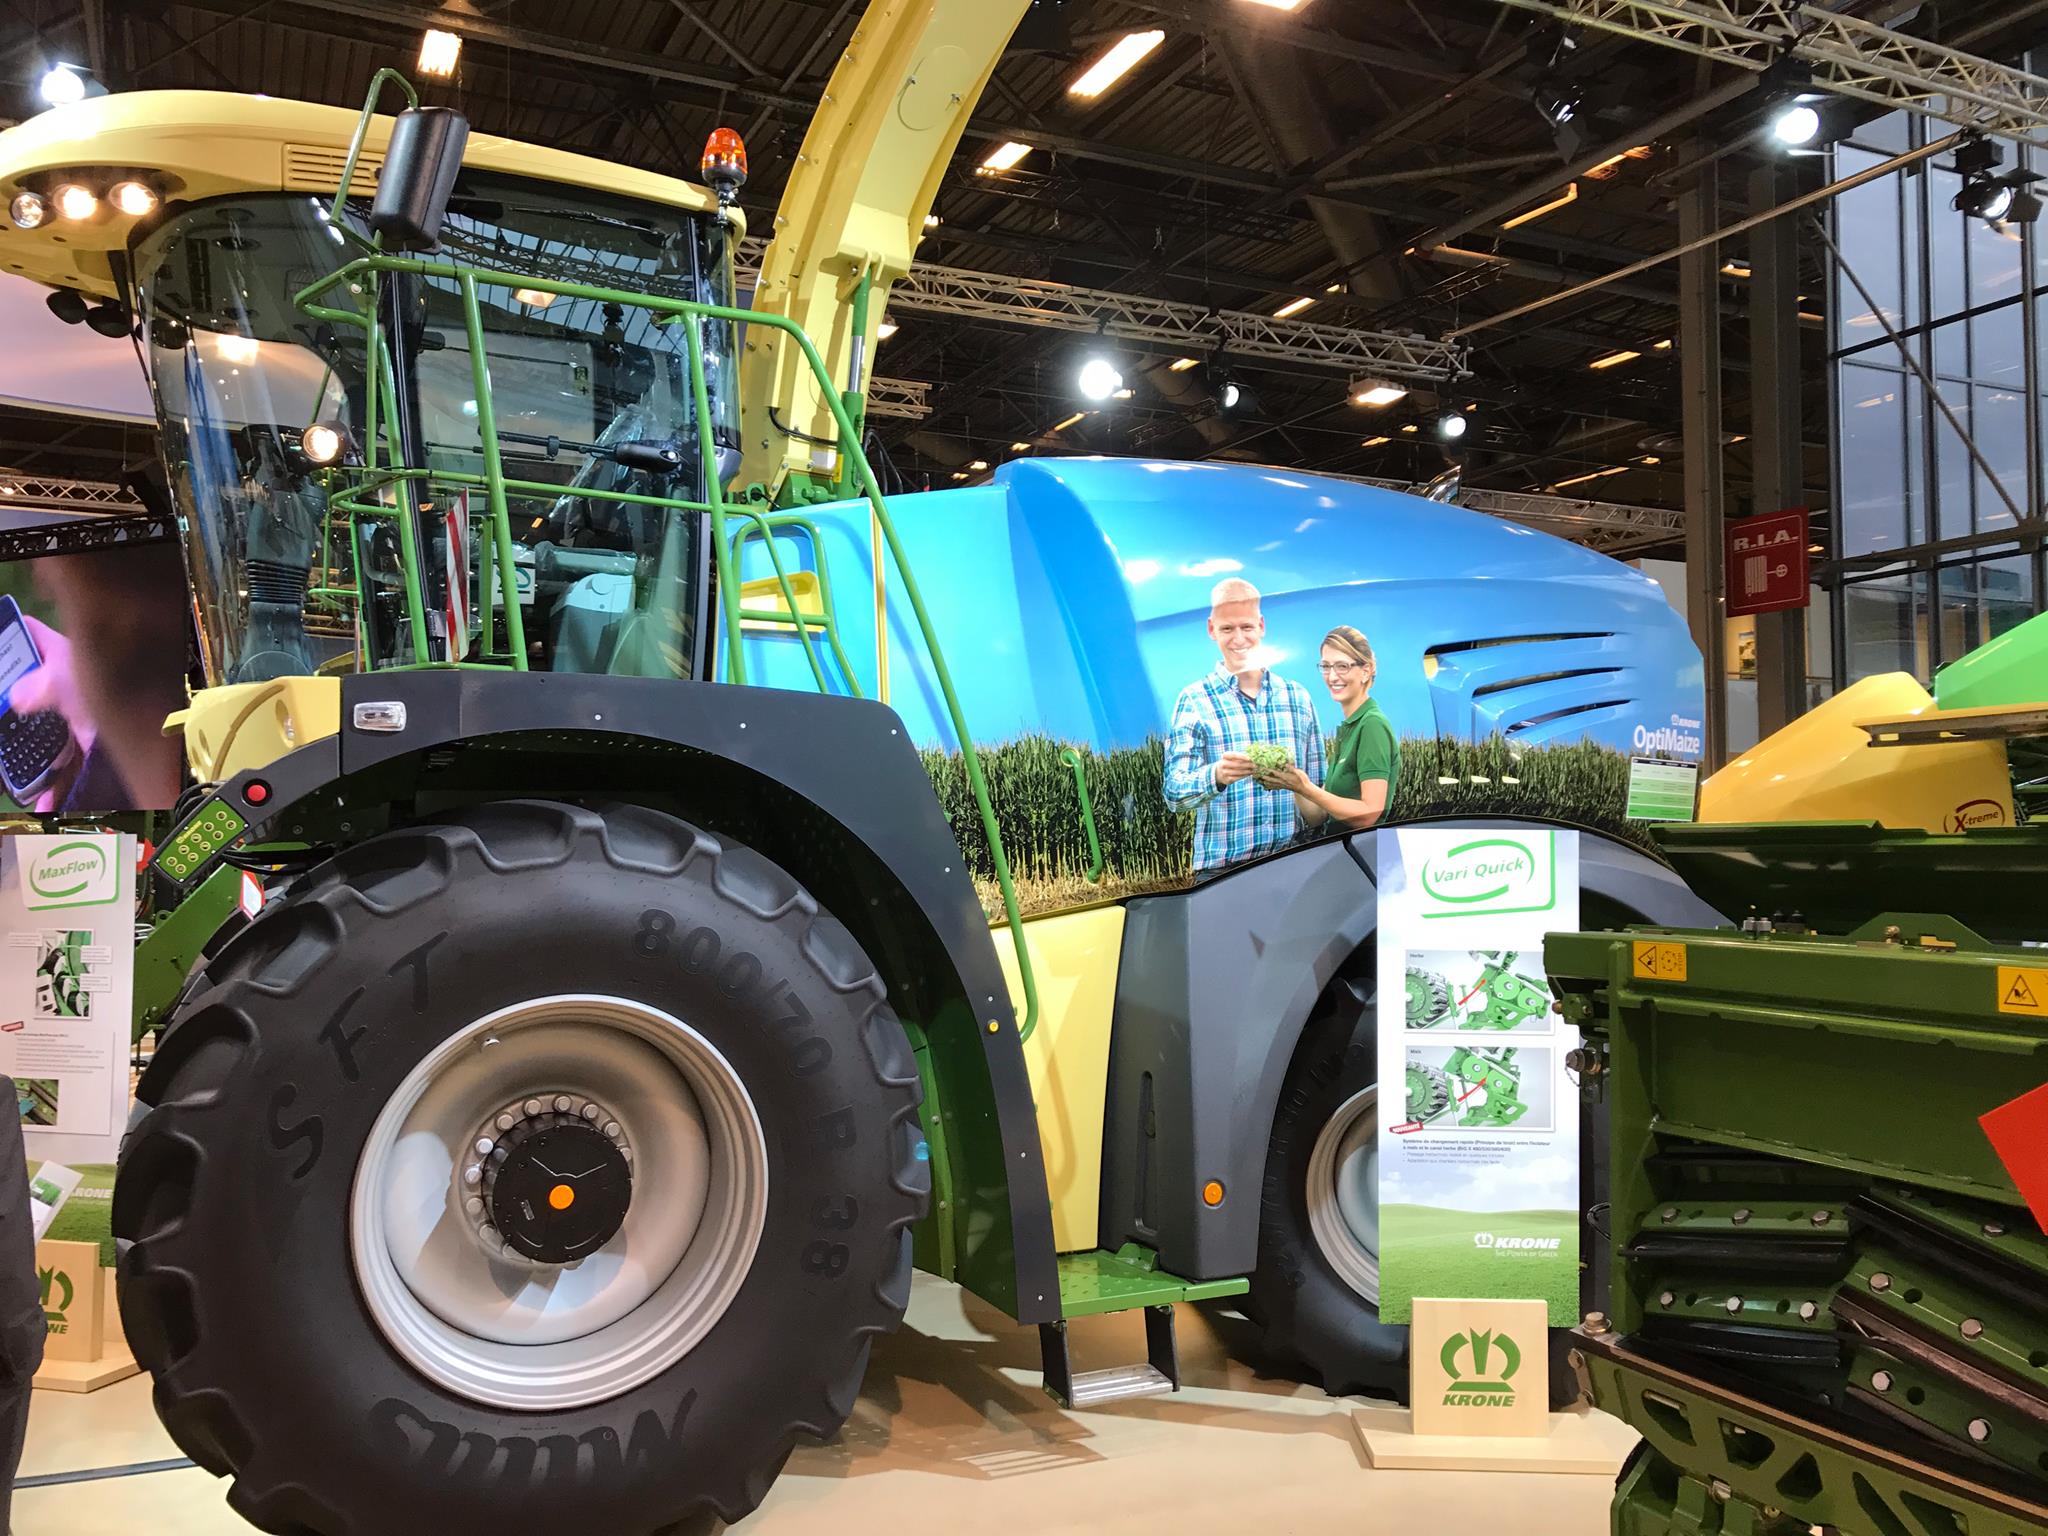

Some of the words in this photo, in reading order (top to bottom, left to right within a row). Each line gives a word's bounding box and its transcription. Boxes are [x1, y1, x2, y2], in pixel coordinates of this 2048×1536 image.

[1734, 529, 1799, 551] R.I.A.
[1633, 724, 1700, 755] OptiMaize
[1954, 812, 1998, 832] X-treme
[39, 860, 98, 880] MaxFlow
[1434, 866, 1468, 883] Vari
[1474, 857, 1524, 878] Quick
[633, 908, 833, 1079] 800/70
[800, 1193, 860, 1279] 38
[1495, 1237, 1561, 1249] KRONE
[1442, 1394, 1516, 1407] KRONE
